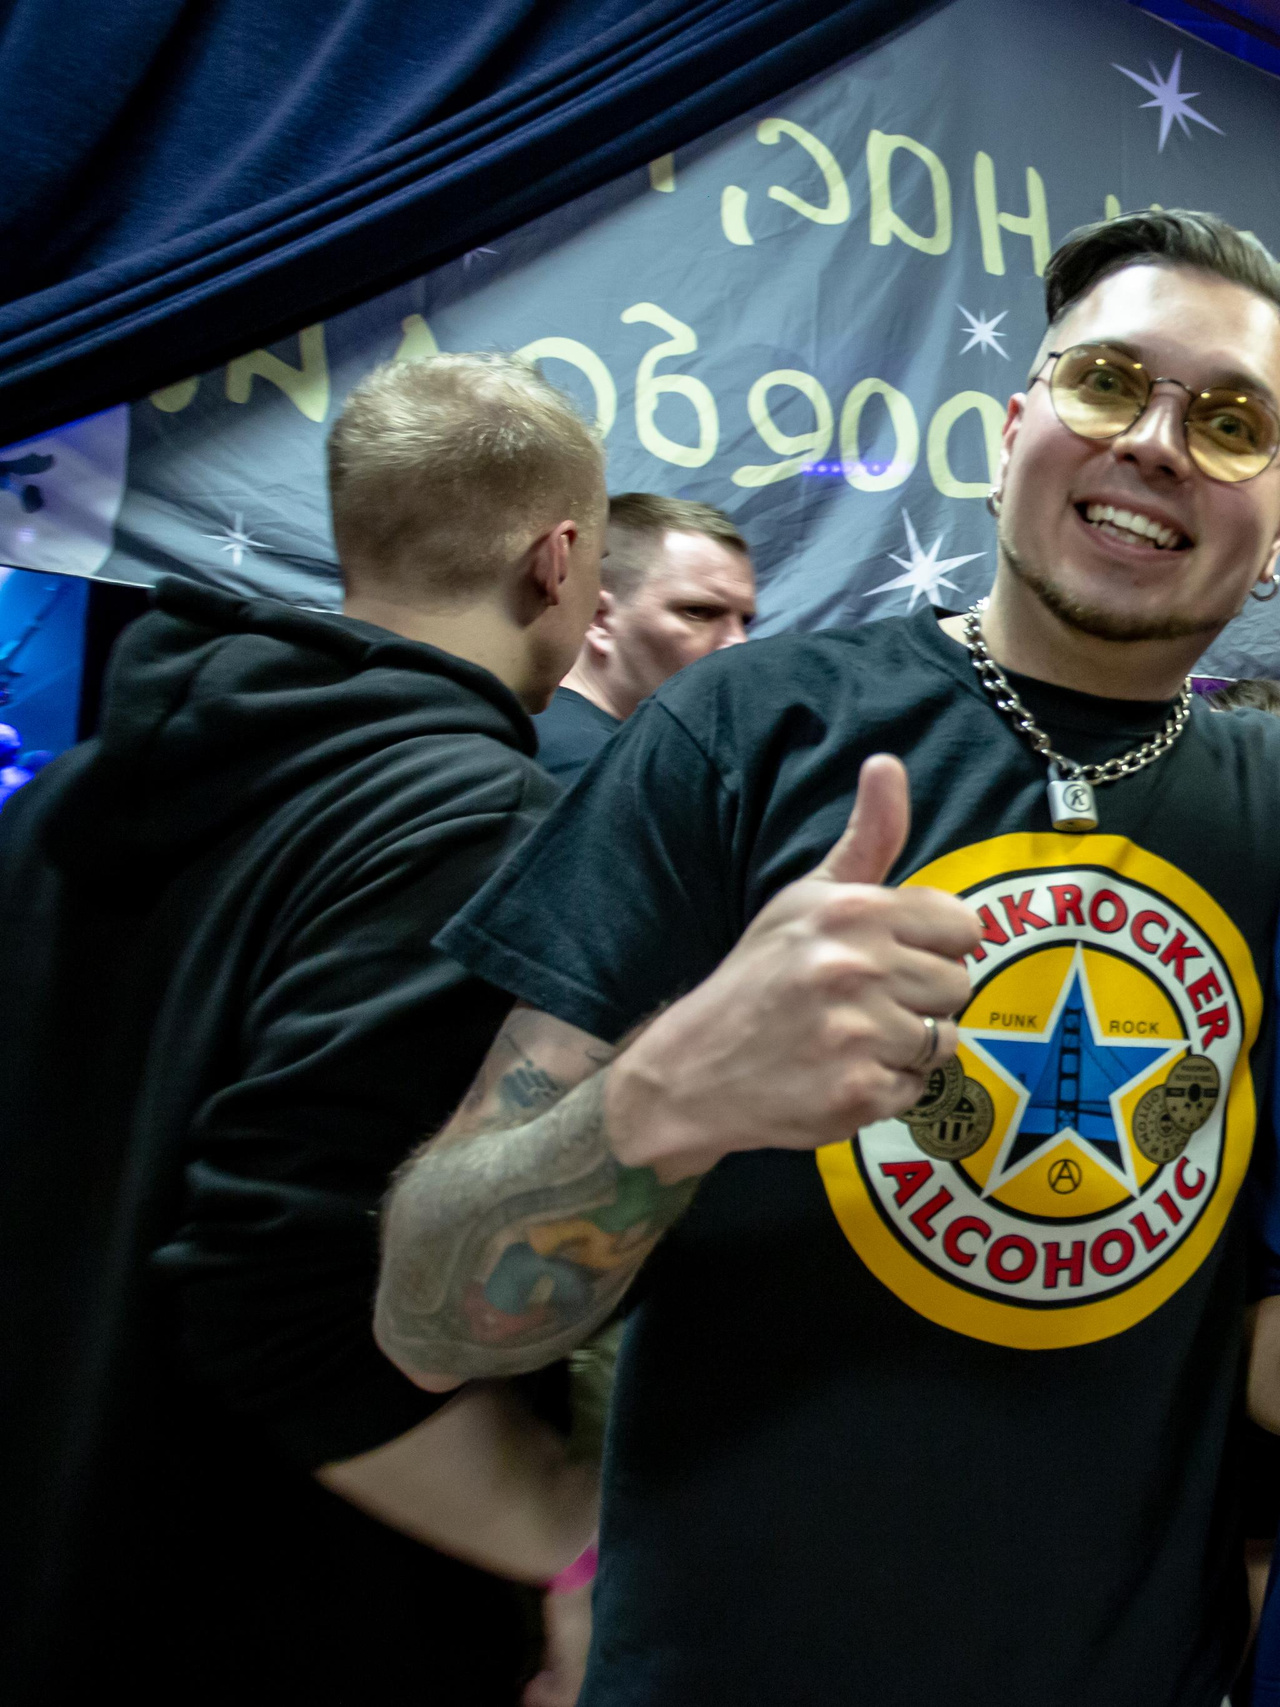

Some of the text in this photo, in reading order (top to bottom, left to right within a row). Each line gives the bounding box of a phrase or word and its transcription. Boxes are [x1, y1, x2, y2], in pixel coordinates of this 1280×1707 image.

[959, 884, 1231, 1052] NKROCKER
[989, 1012, 1038, 1029] PUNK
[1109, 1020, 1160, 1035] ROCK
[878, 1156, 1207, 1289] ALCOHOLIC
